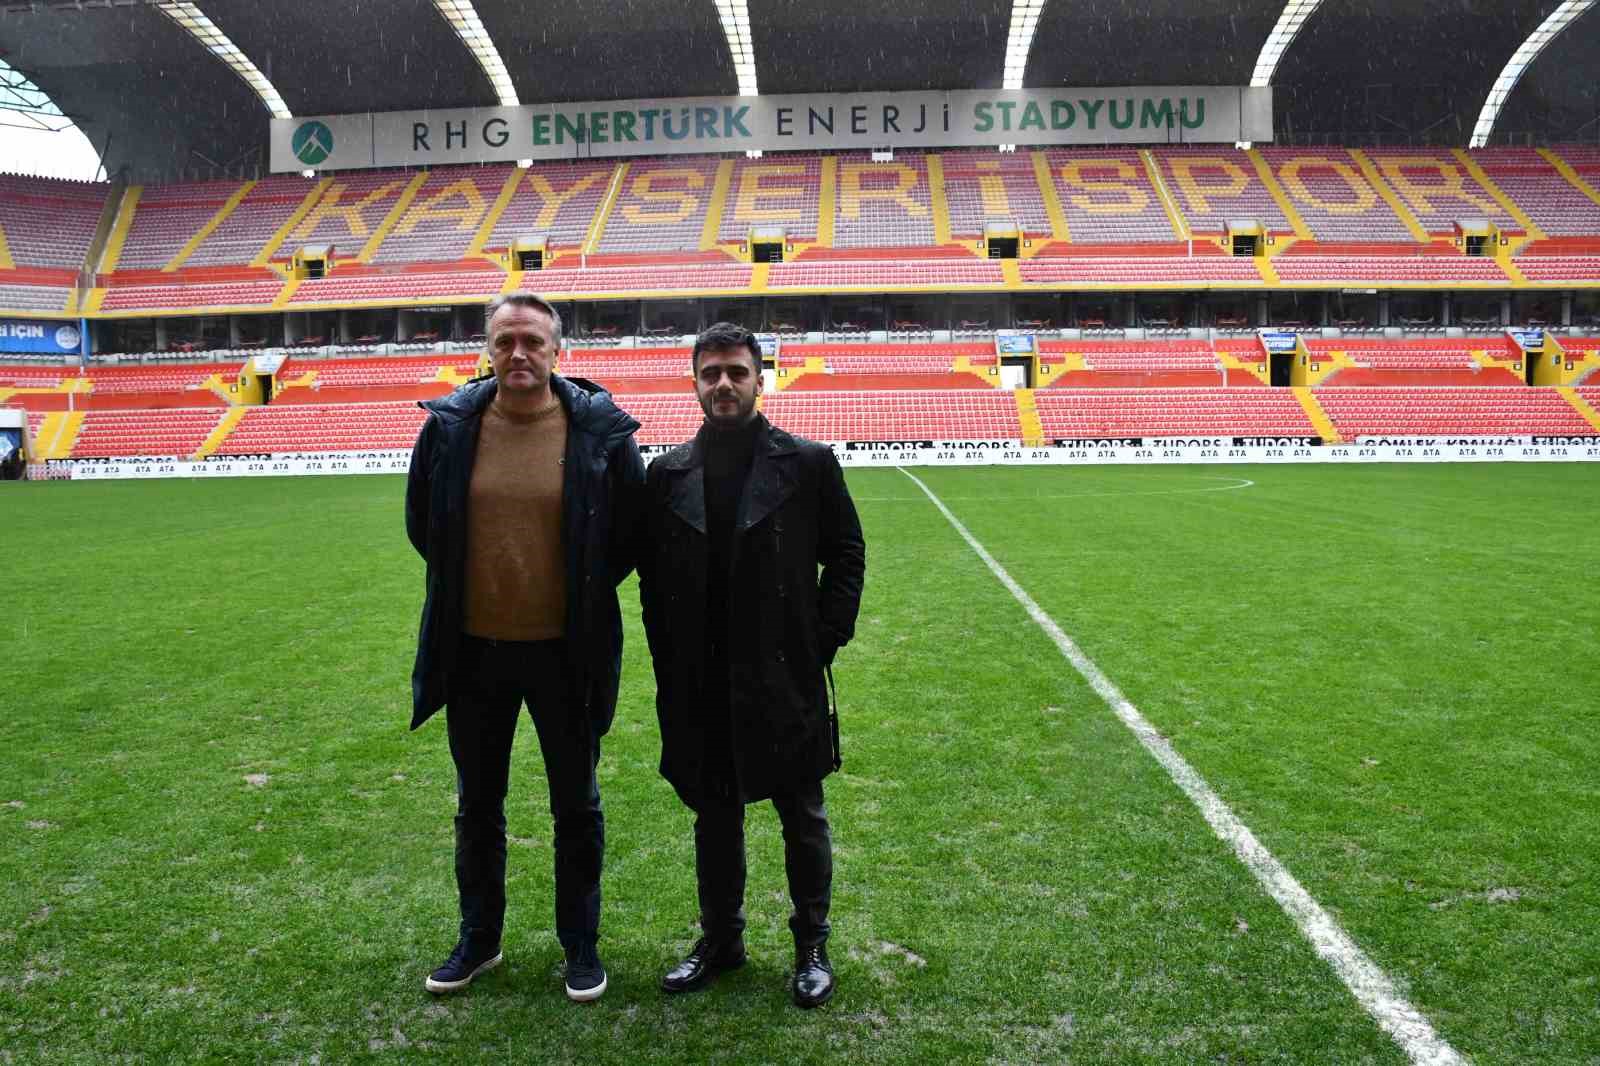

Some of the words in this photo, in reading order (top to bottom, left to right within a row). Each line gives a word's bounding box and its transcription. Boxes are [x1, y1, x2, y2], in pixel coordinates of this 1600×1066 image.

[411, 118, 509, 151] RHG
[532, 105, 753, 146] ENERTÜRK
[973, 97, 1206, 134] STADYUMU
[899, 452, 918, 460] ATA
[965, 451, 984, 459] ATA
[1003, 451, 1022, 459] ATA
[1097, 450, 1116, 458] ATA
[1228, 449, 1247, 457] ATA
[1265, 449, 1284, 457] ATA
[1359, 449, 1377, 457] ATA
[1423, 448, 1440, 457] ATA
[1458, 448, 1477, 456] ATA
[1522, 448, 1541, 456] ATA
